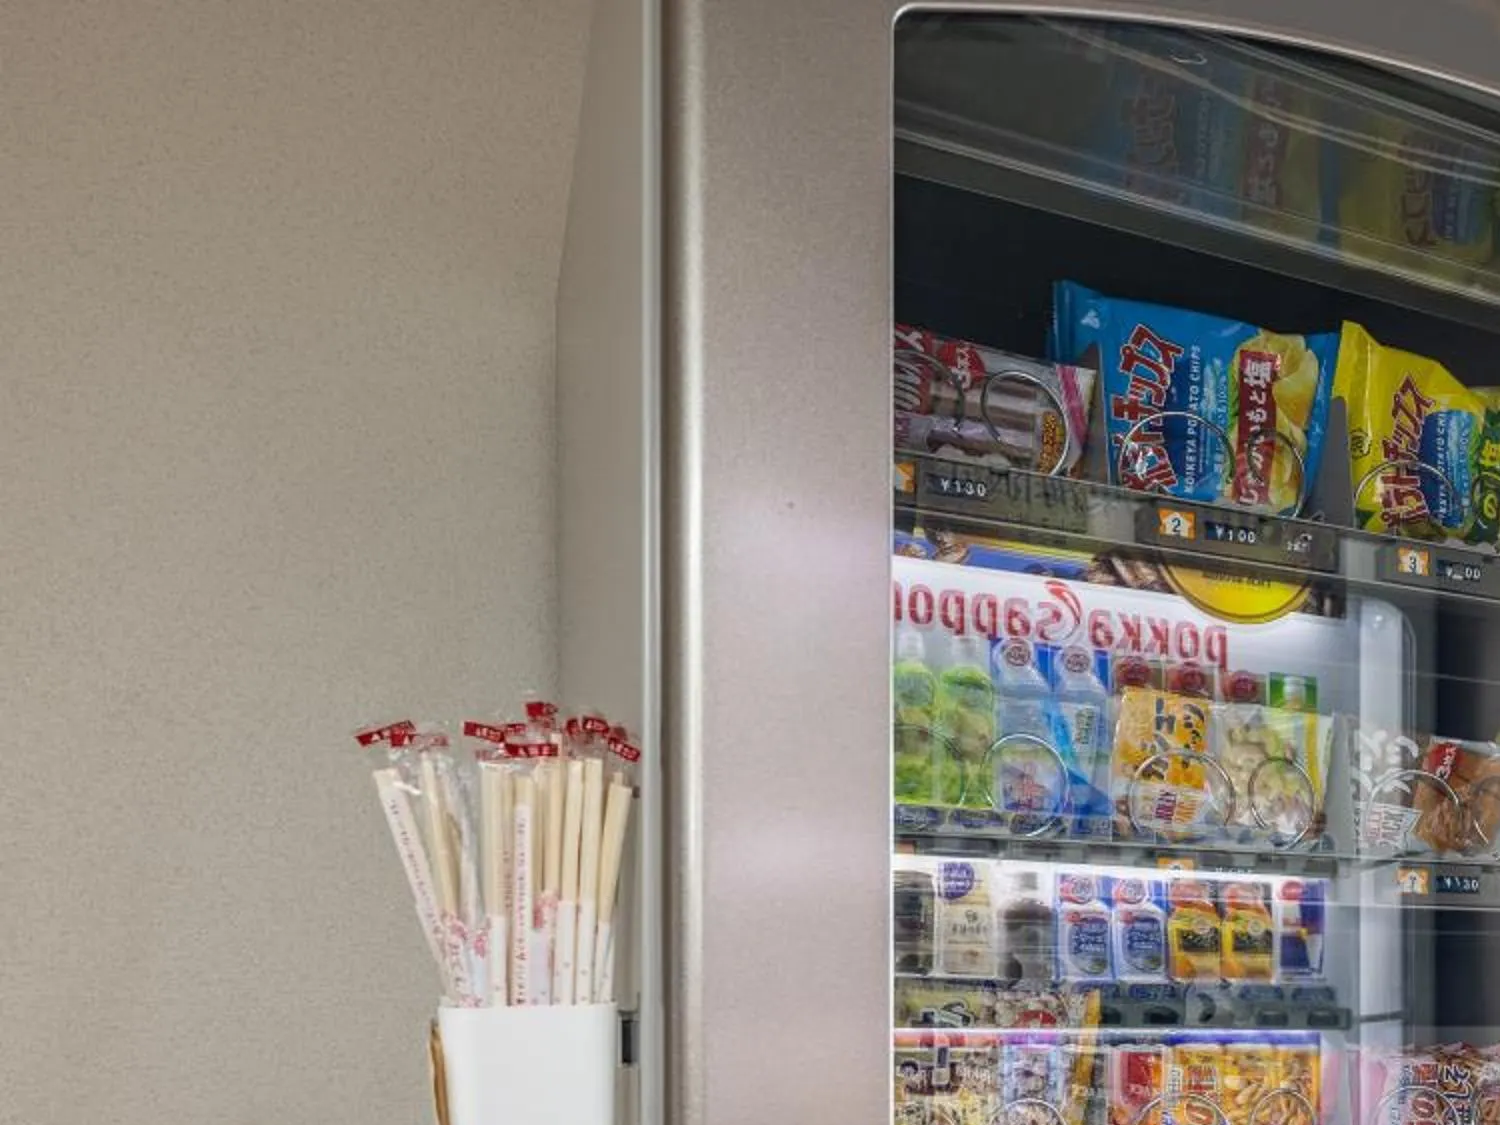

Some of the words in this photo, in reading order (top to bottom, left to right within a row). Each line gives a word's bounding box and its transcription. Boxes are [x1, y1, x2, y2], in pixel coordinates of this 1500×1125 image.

[940, 477, 987, 497] ¥130
[1171, 517, 1182, 534] 2
[1216, 524, 1256, 543] ¥100
[1407, 555, 1418, 573] 3
